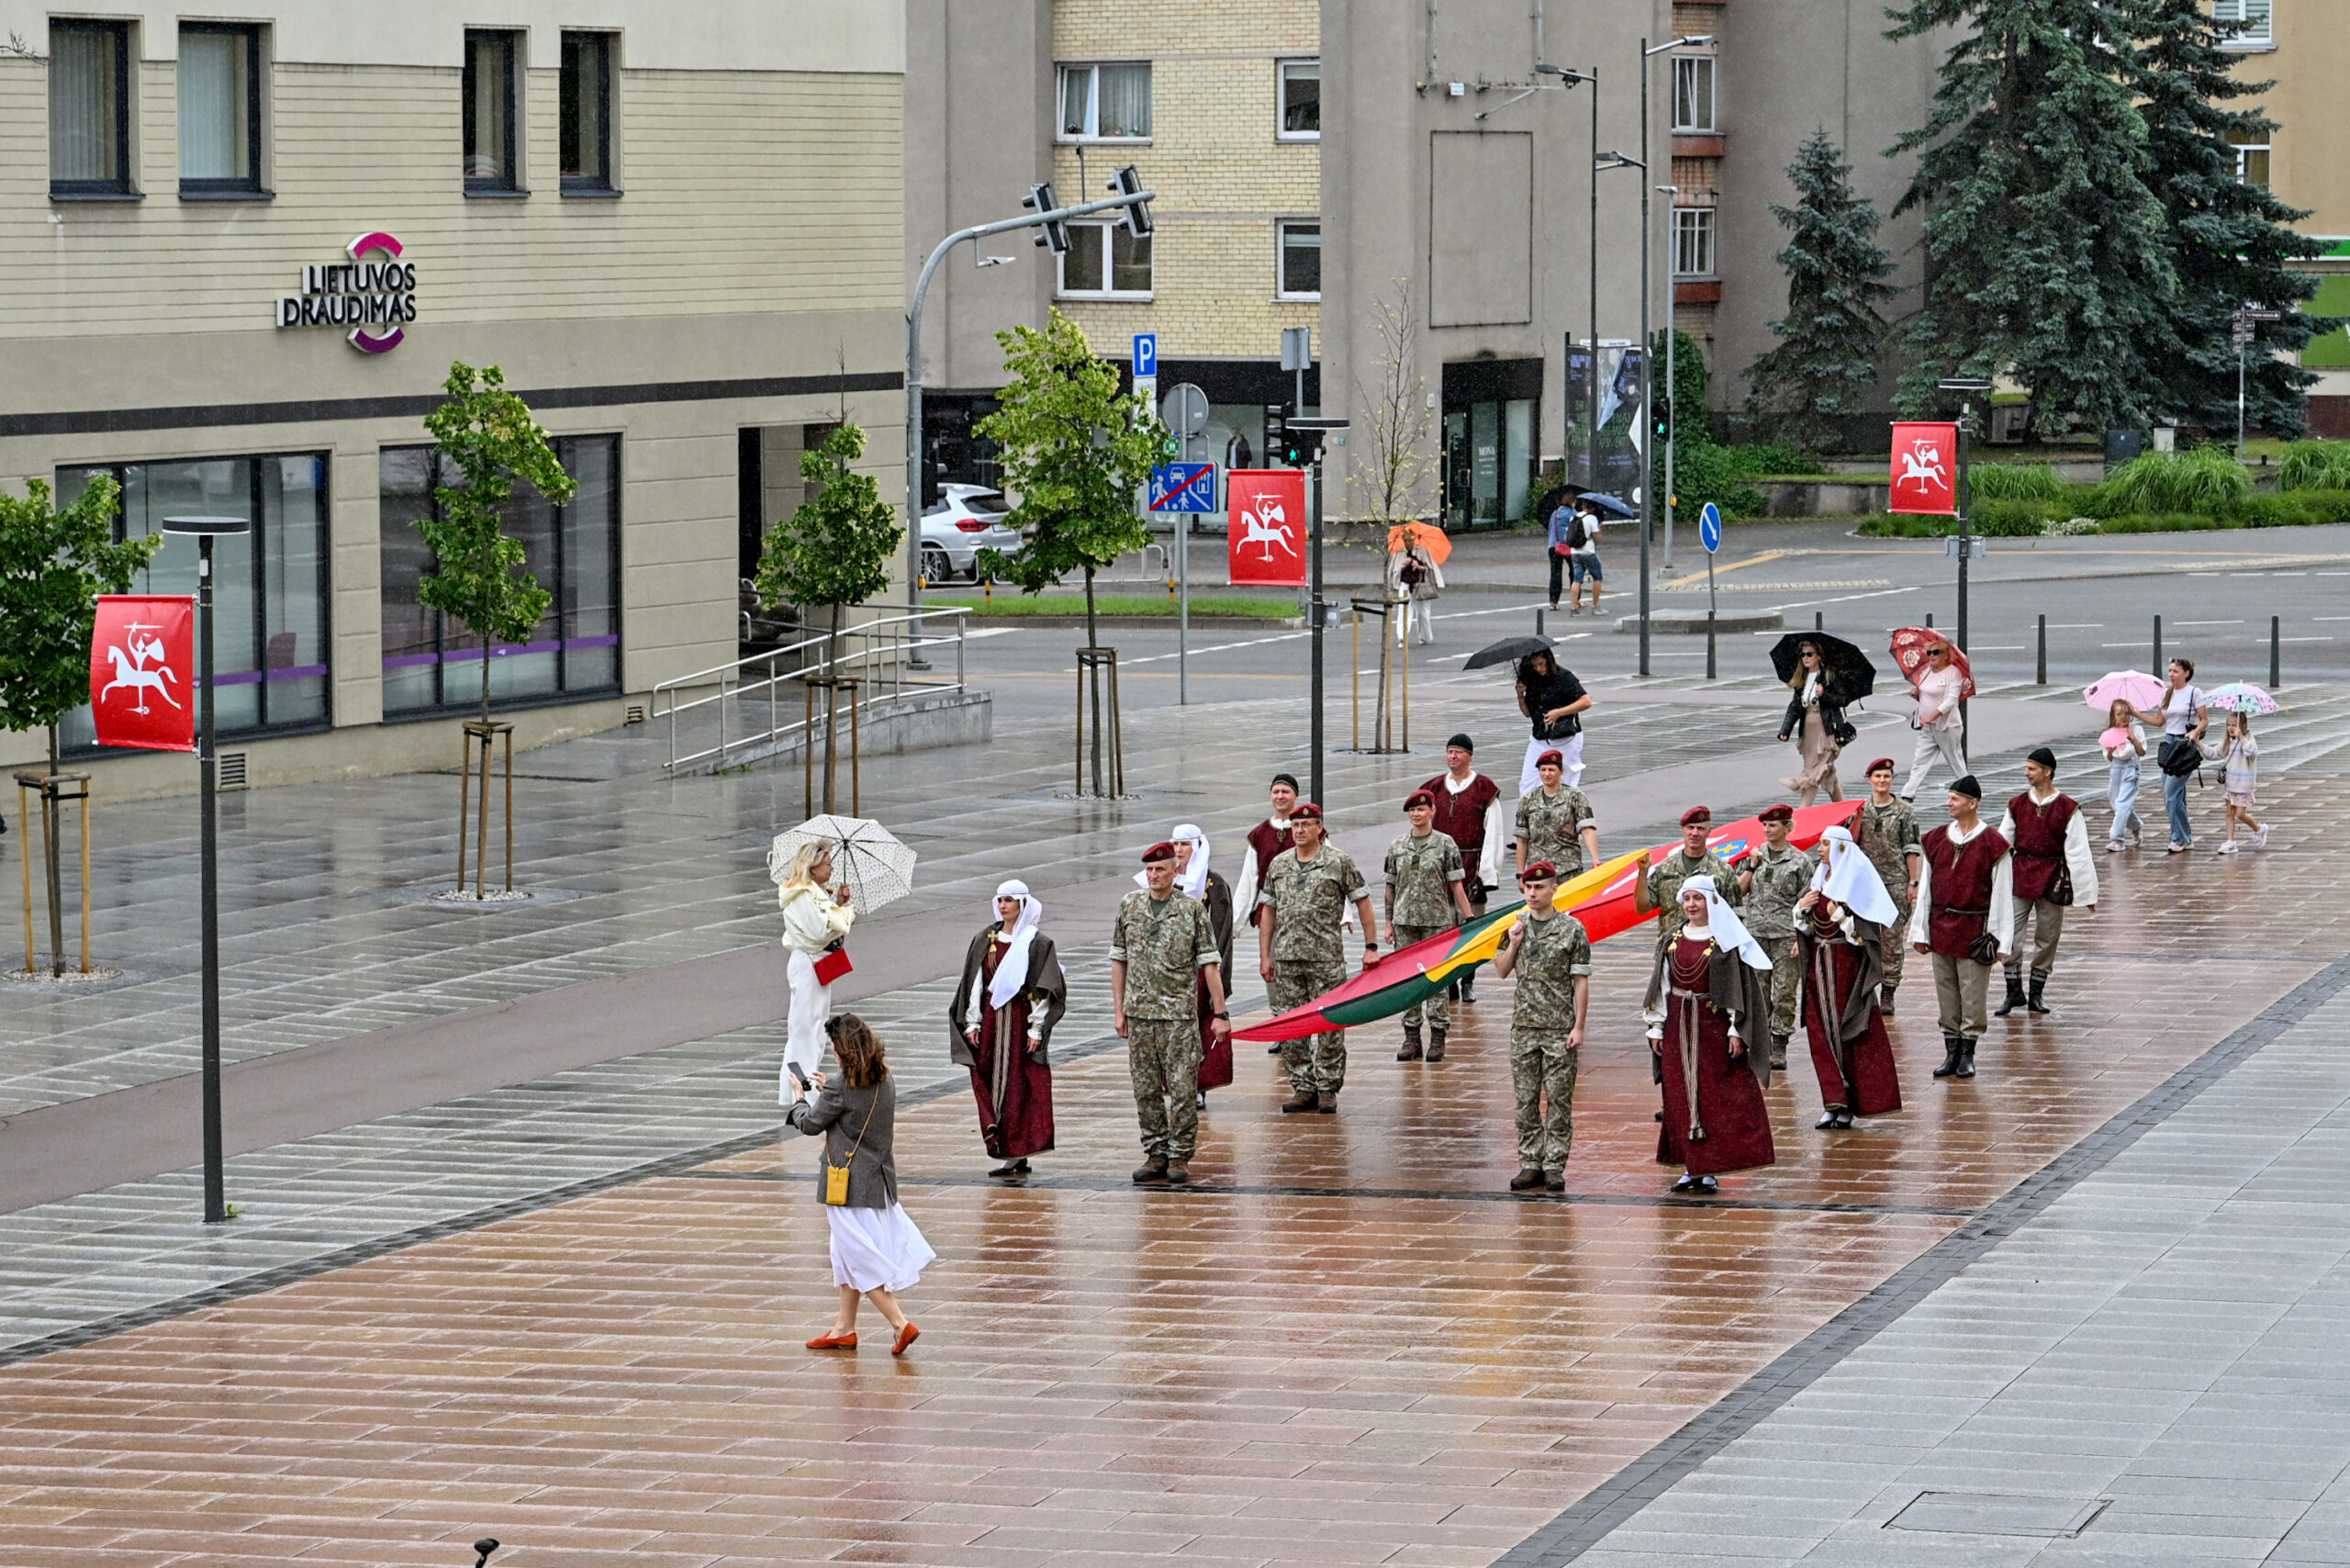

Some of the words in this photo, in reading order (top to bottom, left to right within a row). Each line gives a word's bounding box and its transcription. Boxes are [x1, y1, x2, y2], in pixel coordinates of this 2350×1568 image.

[308, 263, 417, 295] LIETUVOS
[282, 294, 417, 327] DRAUDIMAS
[1139, 338, 1153, 373] P
